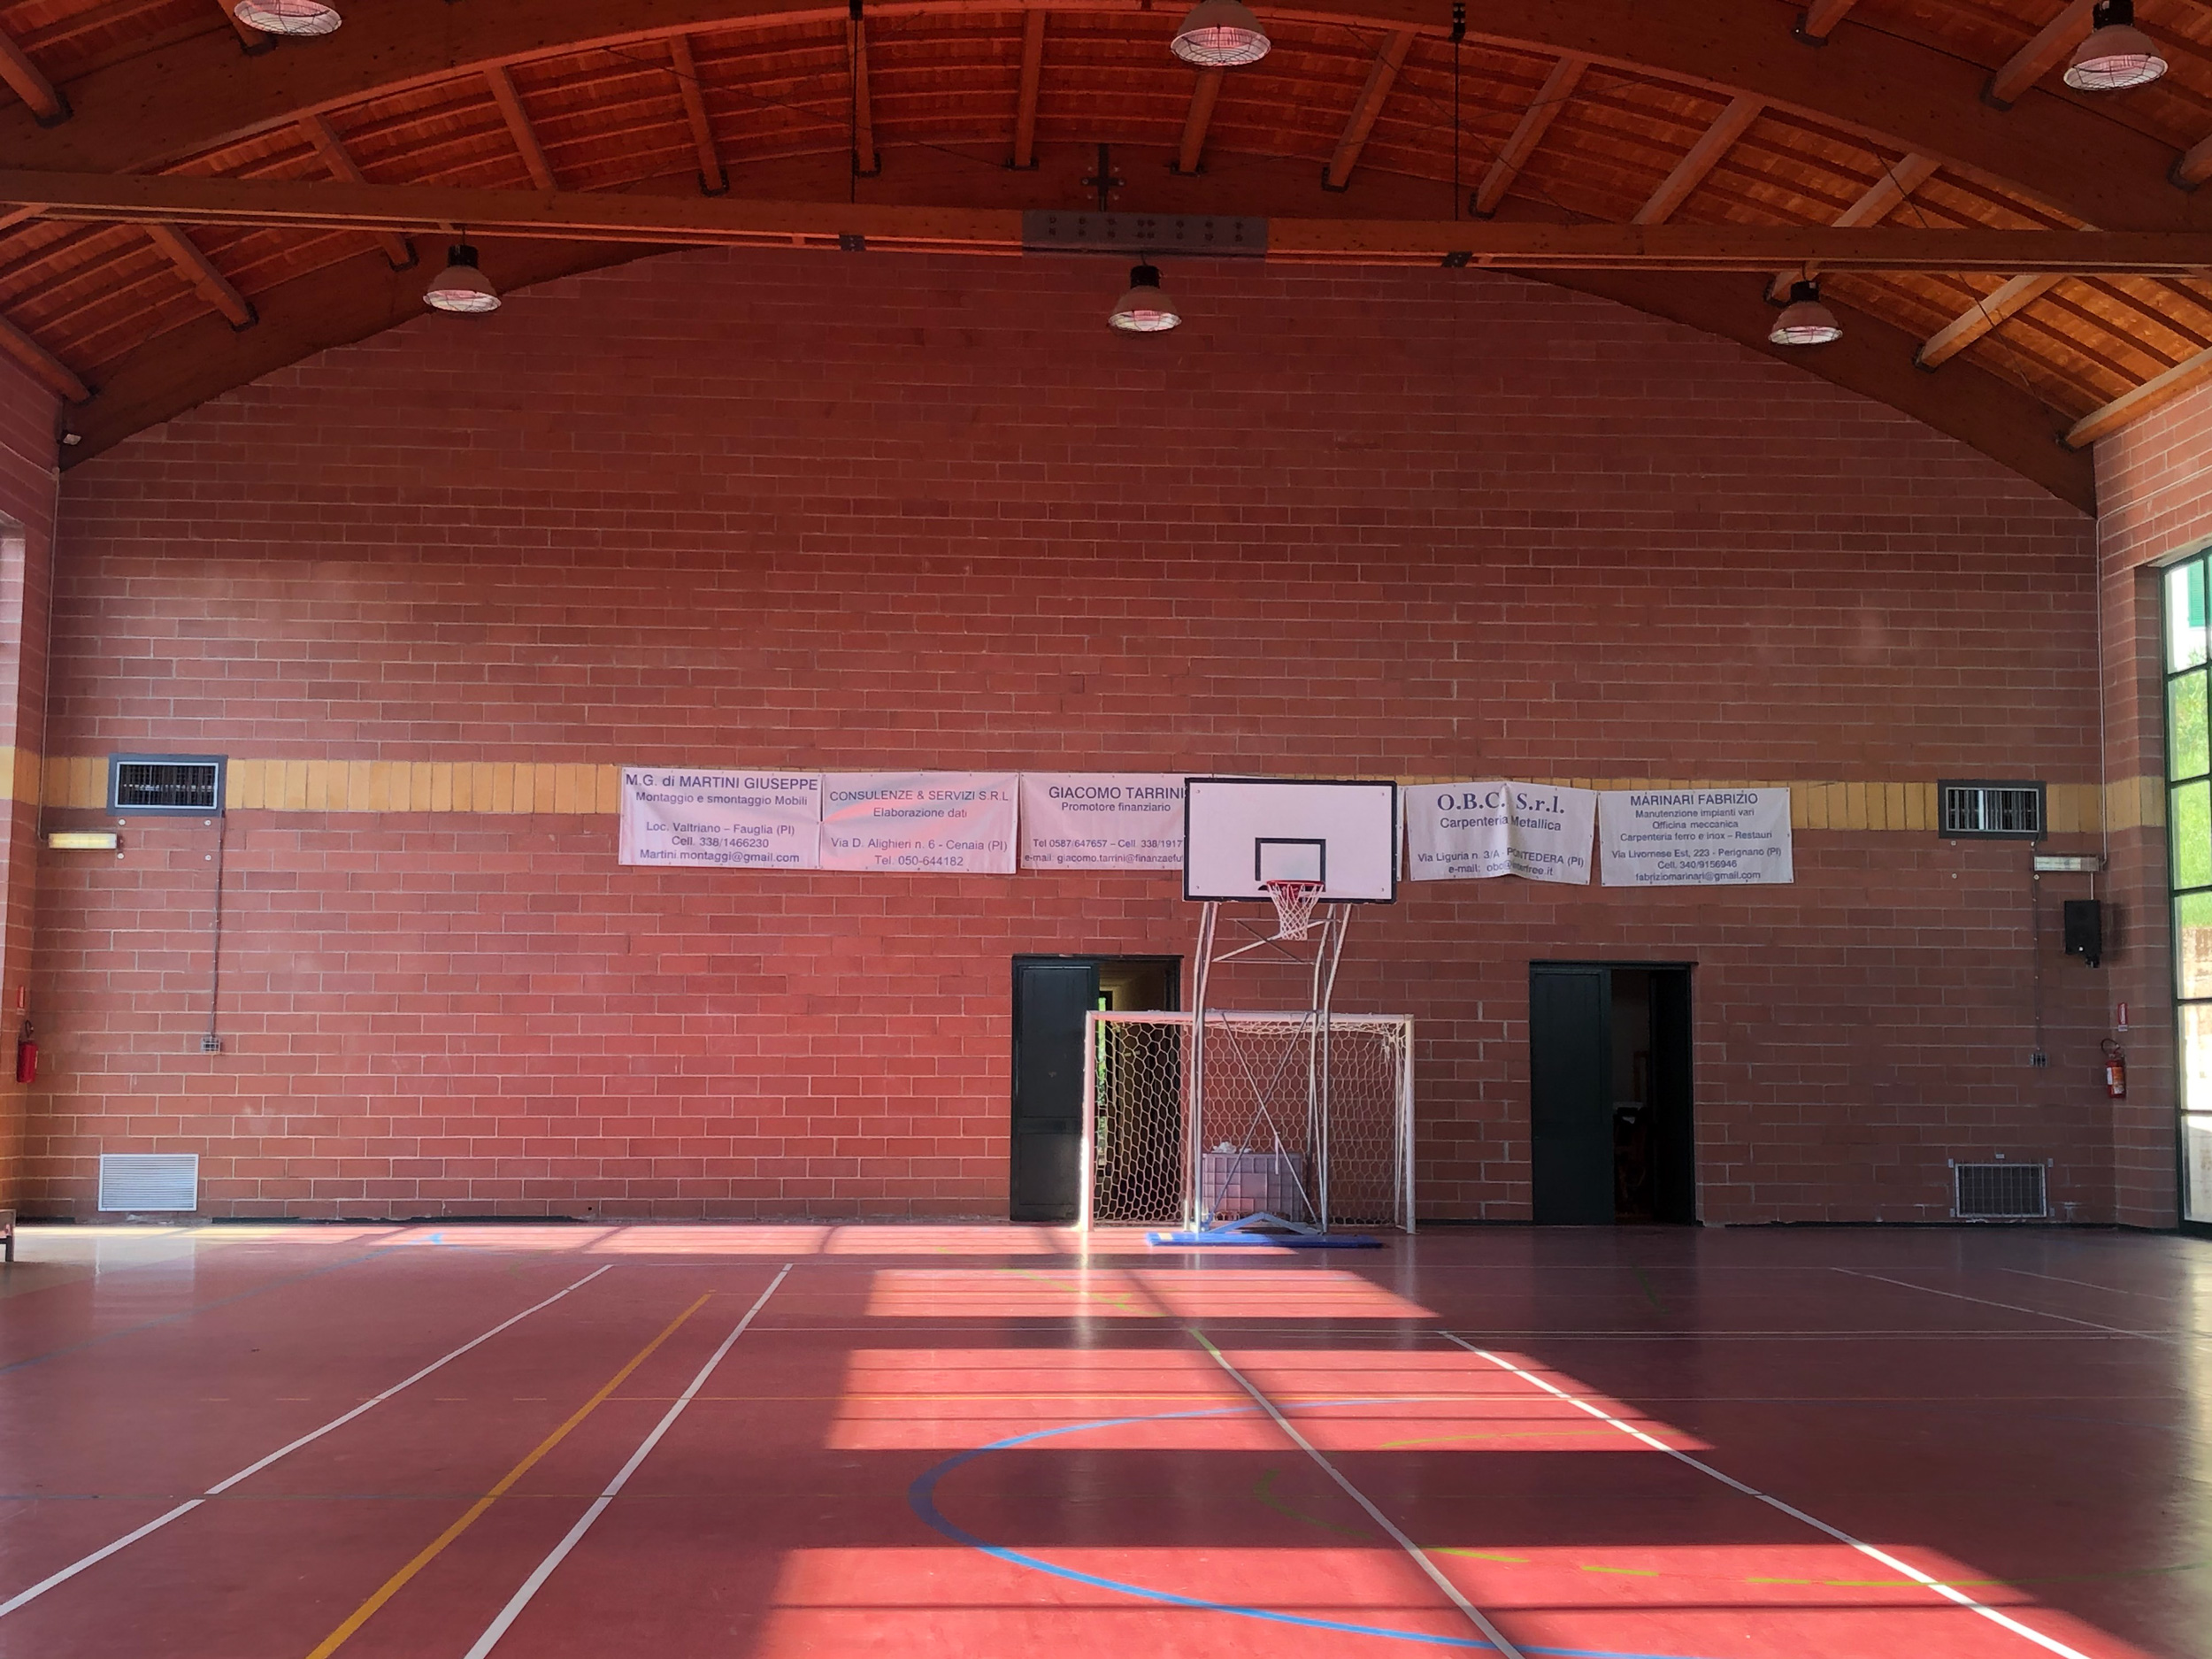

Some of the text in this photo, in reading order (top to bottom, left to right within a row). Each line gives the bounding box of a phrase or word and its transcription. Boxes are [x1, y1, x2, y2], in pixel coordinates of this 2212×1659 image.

[626, 774, 818, 790] M.G. di MARTINI GIUSEPPE
[830, 790, 913, 801] CONSULENZE
[917, 791, 925, 800] &
[928, 791, 975, 801] SERVIZI
[1048, 787, 1184, 799] GIACOMO TARRINI
[636, 792, 694, 804] Montaggio
[707, 795, 772, 806] smontaggio
[775, 795, 808, 805] Mobili
[1437, 792, 1565, 813] O.B.C. S.r.l.
[1631, 794, 1758, 806] MARINARI FABRIZIO
[1062, 803, 1171, 811] Promotore finanziario
[873, 808, 967, 818] Elaborazione dati
[1635, 810, 1698, 818] Manutenzione
[1701, 809, 1736, 818] impianti
[647, 822, 669, 832] Loc.
[673, 823, 720, 833] Valtriano
[733, 825, 772, 835] Fauglia
[777, 826, 795, 835] (PI)
[1440, 816, 1562, 831] Carpenteria Metallica
[1691, 820, 1738, 829] meccanica
[1620, 833, 1672, 842] Carpenteria
[1735, 830, 1772, 839] Restauri
[672, 836, 769, 848] Cell. 338/1466230
[831, 838, 849, 848] Via
[852, 838, 864, 848] D.
[868, 839, 911, 850] Alighieri
[915, 840, 925, 849] n.
[928, 840, 935, 849] 6
[946, 840, 984, 850] Cenaia
[988, 841, 1008, 851] (PI)
[1141, 840, 1182, 849] 338/1917
[1418, 853, 1433, 862] Via
[1436, 852, 1470, 863] Liguria
[1483, 849, 1500, 859] 3/A
[1507, 848, 1564, 864] PONTEDERA
[1567, 856, 1585, 868] (PI)
[1718, 849, 1764, 858] Perignano
[1767, 848, 1781, 856] (PI)
[875, 855, 964, 866] Tel. 050-644182
[1057, 854, 1183, 864] giacomo.tarrini@finanzaefu
[1679, 859, 1737, 869] 340/9156946
[1448, 864, 1481, 873] e-mail:
[1636, 872, 1761, 881] fabriziomarinari@gmail.com
